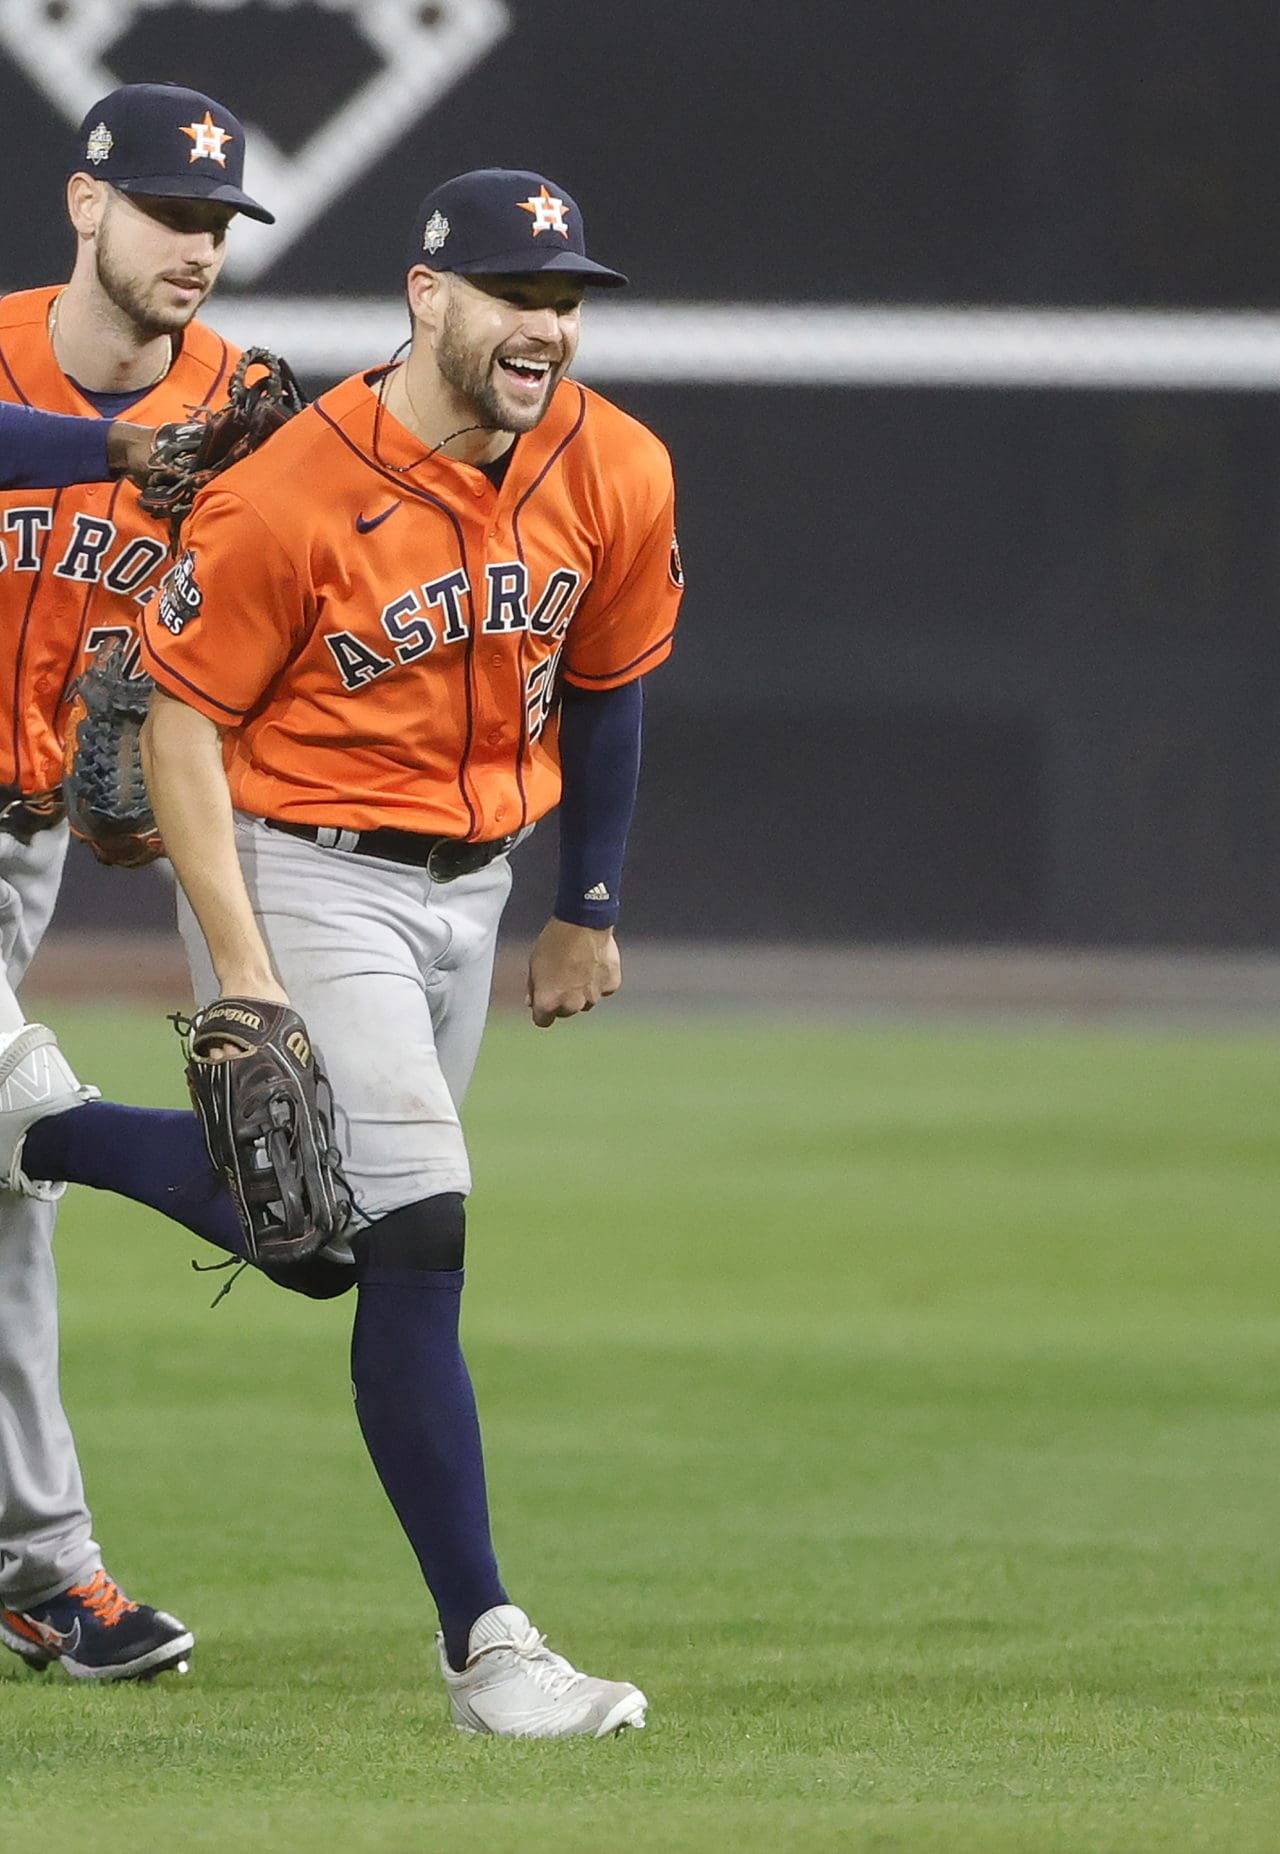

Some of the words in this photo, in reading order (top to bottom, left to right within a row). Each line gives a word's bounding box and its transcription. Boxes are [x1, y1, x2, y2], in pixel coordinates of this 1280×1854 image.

[190, 122, 227, 161] H
[527, 196, 569, 232] H
[174, 562, 201, 607] ORLD
[160, 593, 184, 634] RIES
[323, 560, 592, 692] ASTRO
[207, 1007, 262, 1031] Wilson
